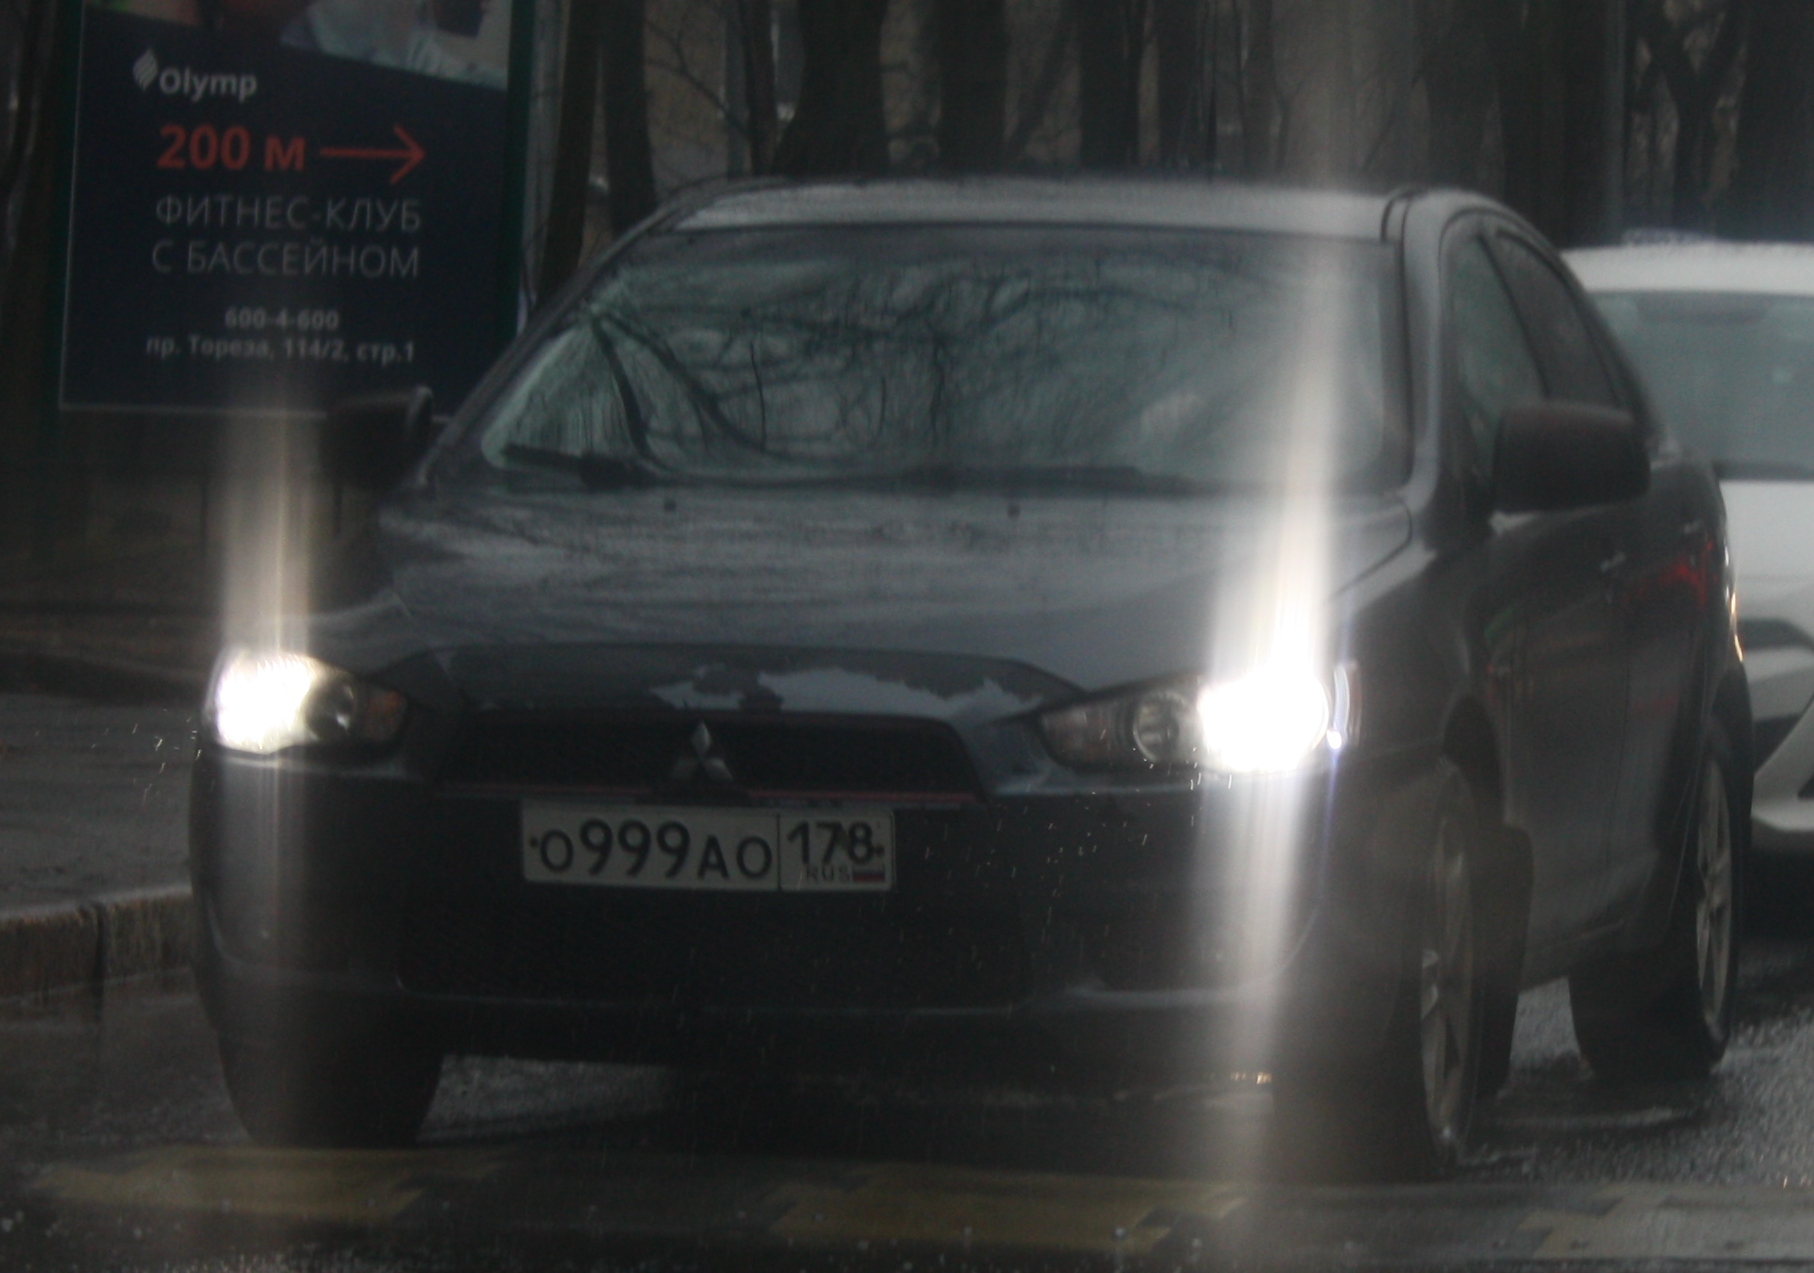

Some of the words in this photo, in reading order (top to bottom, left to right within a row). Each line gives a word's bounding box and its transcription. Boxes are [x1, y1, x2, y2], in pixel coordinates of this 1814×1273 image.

[158, 66, 257, 101] Olymp
[156, 123, 251, 171] 200
[155, 194, 421, 232] ФИТНЕС-КЛУБ
[152, 239, 174, 273] С
[187, 236, 420, 278] БАССЕЙНОМ
[224, 307, 340, 330] 600-4-600
[145, 336, 181, 359] пр.
[188, 334, 274, 360] Тореза,
[786, 820, 873, 865] 178
